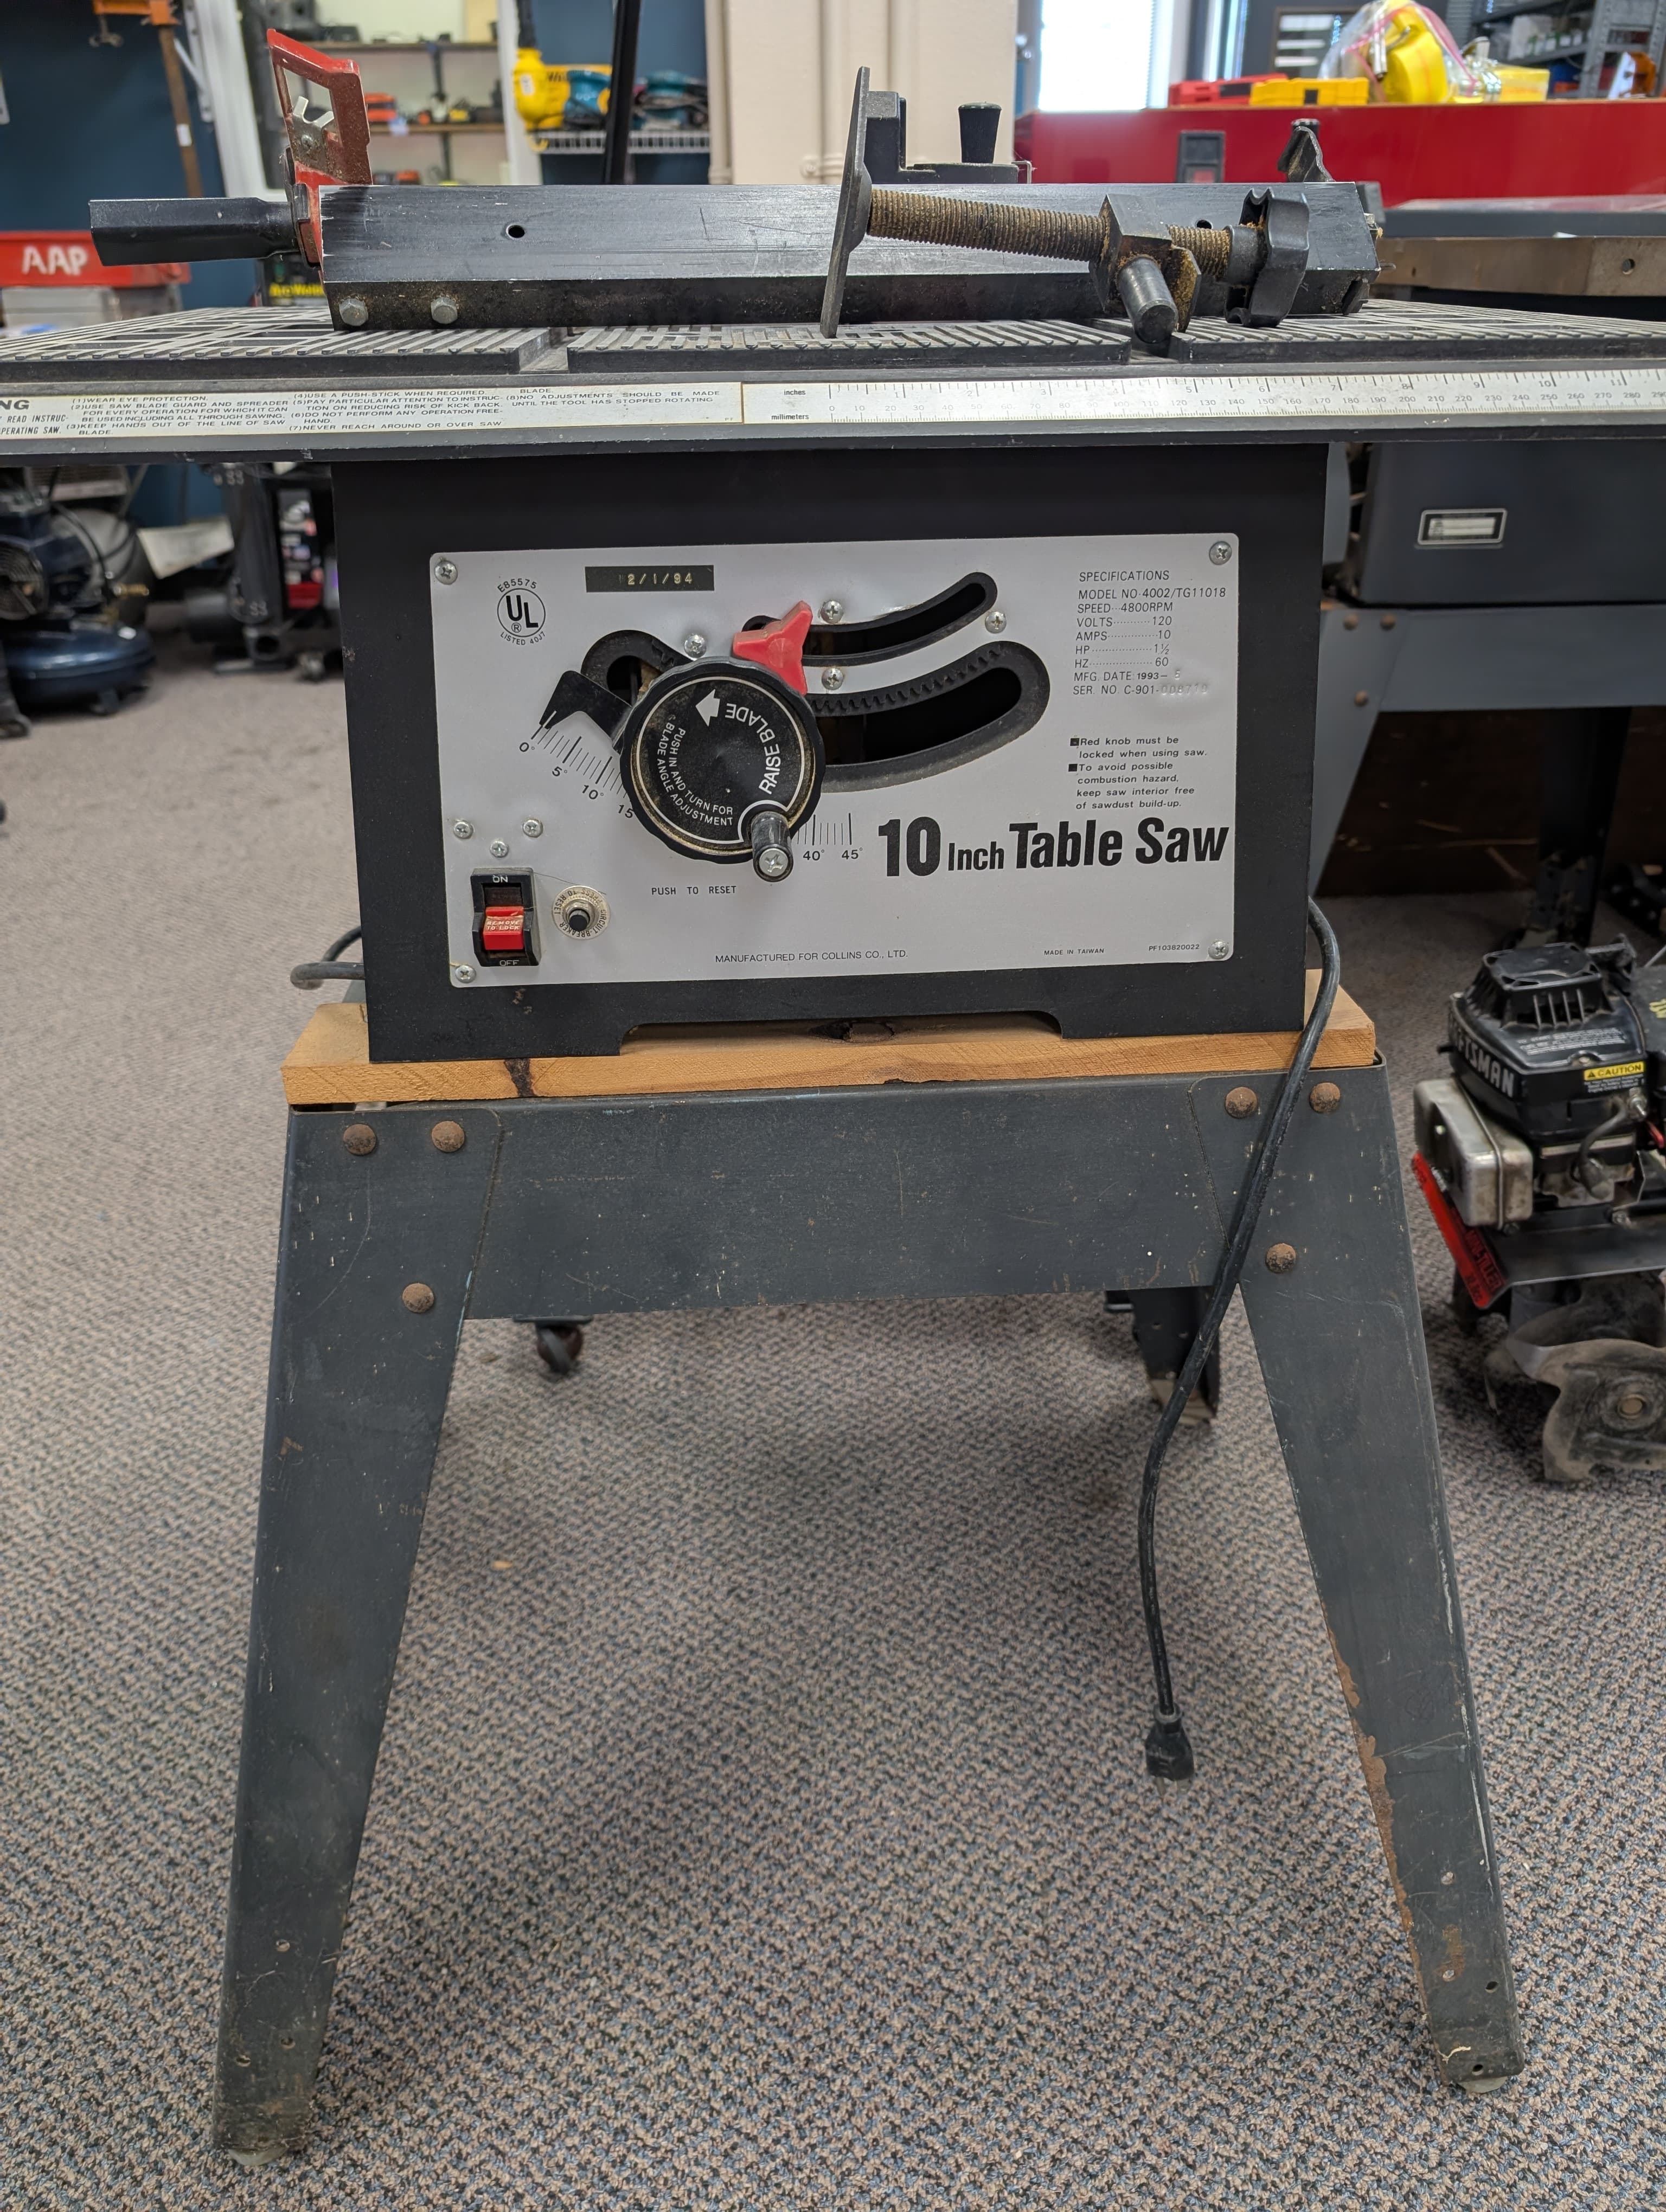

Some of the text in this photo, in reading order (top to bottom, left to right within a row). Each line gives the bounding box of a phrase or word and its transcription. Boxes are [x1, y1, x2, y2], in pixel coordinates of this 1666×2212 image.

[22, 245, 88, 275] AAP
[32, 414, 69, 422] INSTRUC-
[1079, 570, 1169, 582] SPECIFICATIONS
[497, 578, 537, 593] E85575
[1078, 589, 1117, 600] MODEL
[506, 595, 539, 628] UL
[1077, 602, 1173, 614] SPEED 4800RPM
[1077, 615, 1172, 627] VOLTS 120
[500, 632, 526, 645] LISTED
[1075, 629, 1171, 641] AMPS 10
[1075, 645, 1090, 654] HP
[1075, 657, 1169, 668] HZ 60
[1073, 685, 1094, 695] SER.
[1101, 685, 1119, 695] NO.
[1105, 737, 1131, 745] knob
[725, 703, 781, 795] RAISE BLADE
[1079, 750, 1114, 758] locked
[1152, 749, 1179, 758] using
[669, 728, 733, 815] PUSH IN AND TURN FOR
[1098, 763, 1126, 771] avoid
[1131, 762, 1173, 771] possible
[657, 722, 733, 826] BLADE ANGLE ADJUSTMENT
[1078, 775, 1137, 785] combustion
[1077, 789, 1101, 798] keep
[1132, 787, 1169, 795] interior
[1075, 800, 1181, 809] of sawdust build-up.
[878, 816, 1229, 877] 10 Inch Table Saw
[651, 885, 736, 895] PUSH TO RESET
[554, 895, 567, 915] RESET
[715, 953, 795, 963] MANUFACTURED
[799, 953, 818, 961] FOR
[822, 951, 862, 960] COLLINS
[888, 950, 908, 958] LTD.
[1598, 1063, 1642, 1077] CAUTION
